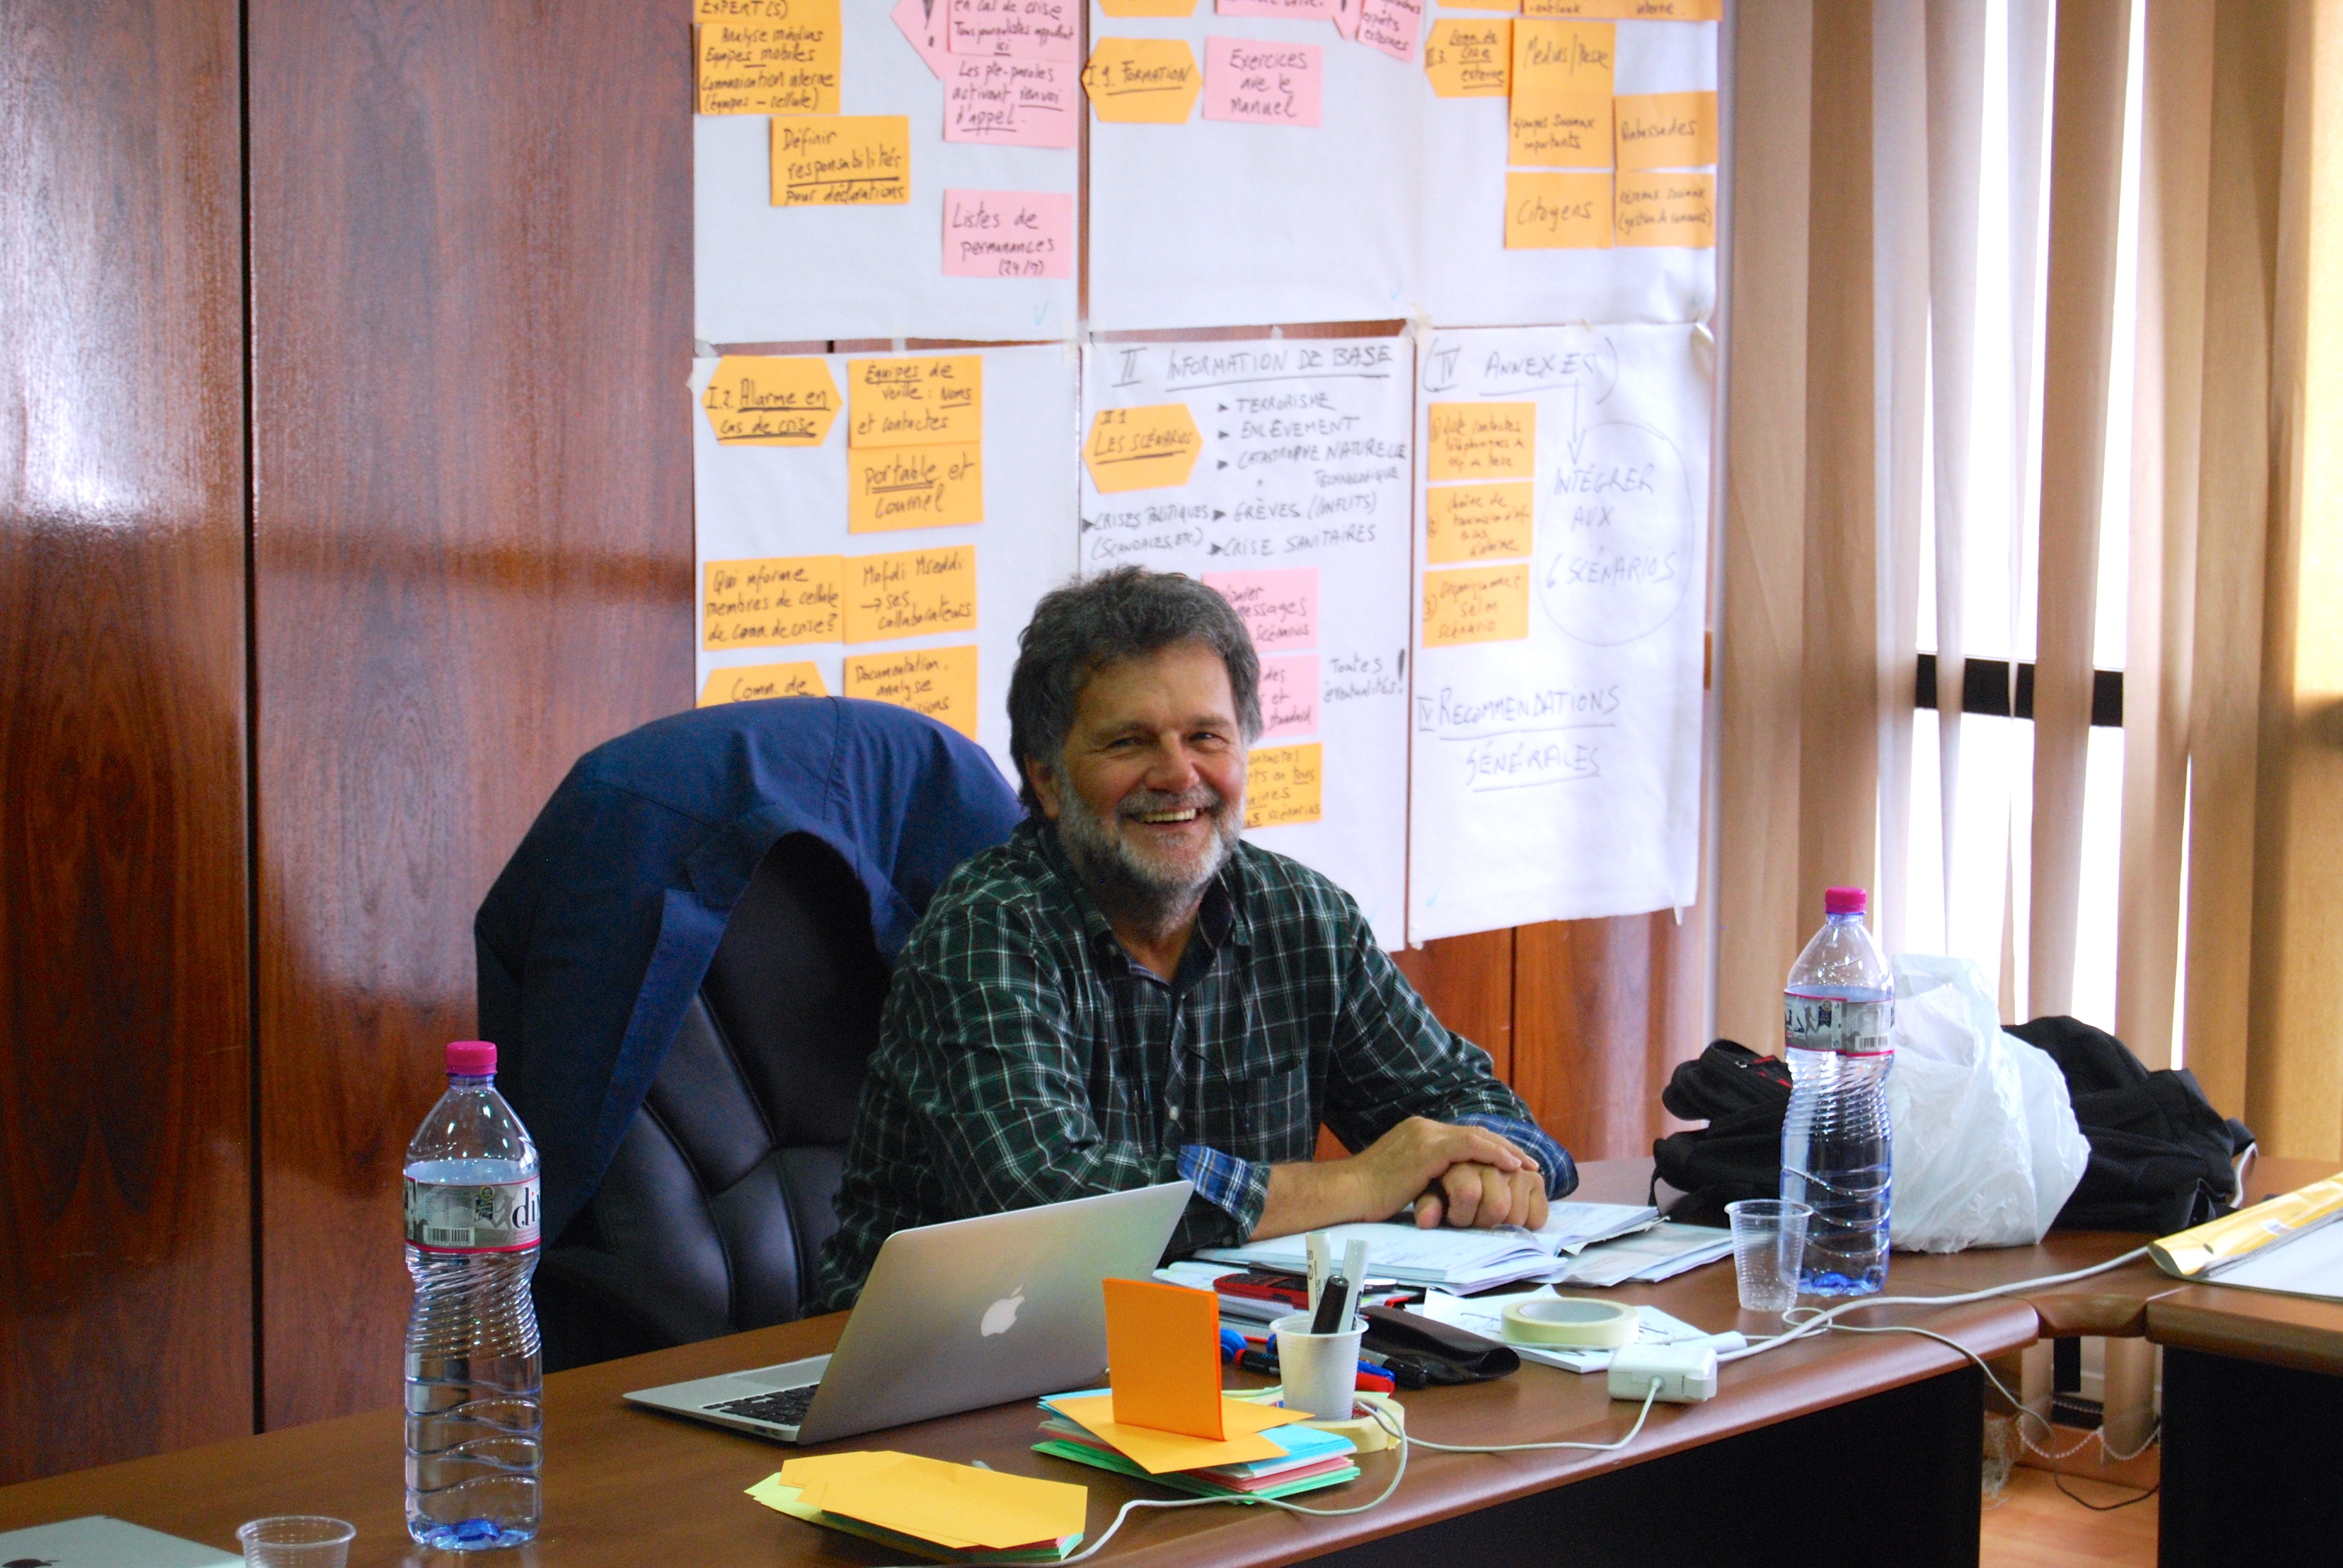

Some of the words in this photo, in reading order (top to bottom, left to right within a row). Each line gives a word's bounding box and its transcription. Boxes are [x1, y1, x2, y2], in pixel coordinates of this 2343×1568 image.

[1230, 48, 1308, 70] Exercices
[952, 201, 1000, 229] Listes
[1014, 207, 1039, 230] de
[1517, 195, 1593, 232] Citoyens
[929, 363, 954, 379] de
[1166, 350, 1289, 381] INFORMATION
[1299, 349, 1323, 370] DE
[1334, 345, 1394, 366] BASE
[739, 377, 798, 408] Alarme
[804, 391, 827, 409] en
[1236, 393, 1337, 413] TERRORISME
[778, 416, 816, 434] crise
[857, 419, 874, 434] et
[865, 454, 940, 495] portable
[948, 452, 975, 480] et
[746, 564, 809, 587] informe
[706, 598, 769, 616] membres
[1329, 652, 1383, 673] Toutes
[512, 1187, 540, 1229] di
